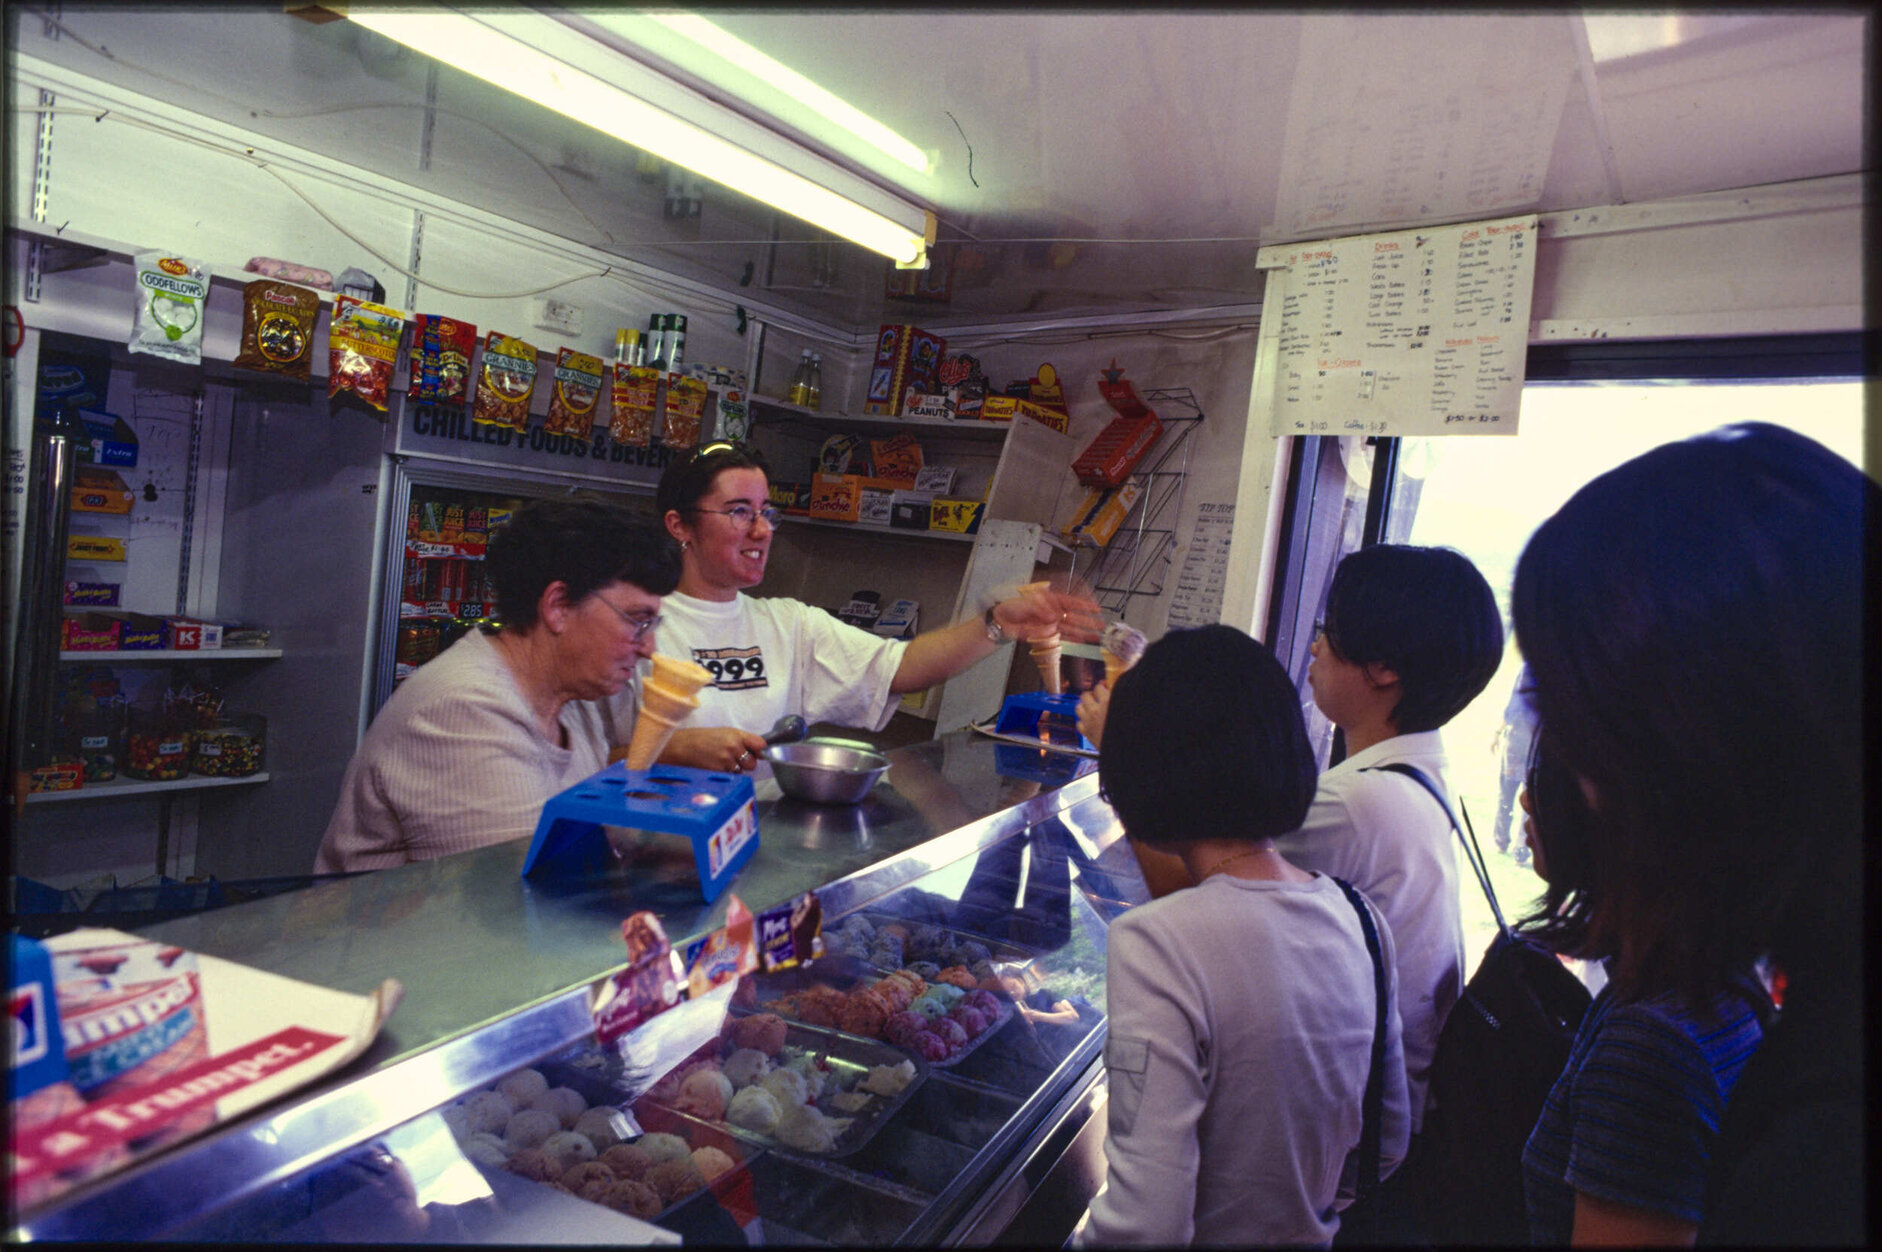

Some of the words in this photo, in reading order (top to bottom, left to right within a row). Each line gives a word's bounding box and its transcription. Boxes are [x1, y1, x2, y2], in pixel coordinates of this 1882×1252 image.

[145, 274, 202, 298] ODDFELLOWS
[908, 406, 951, 418] PEANUTS
[592, 434, 607, 460] &
[696, 656, 764, 681] 999
[79, 1039, 315, 1131] Trumpet.
